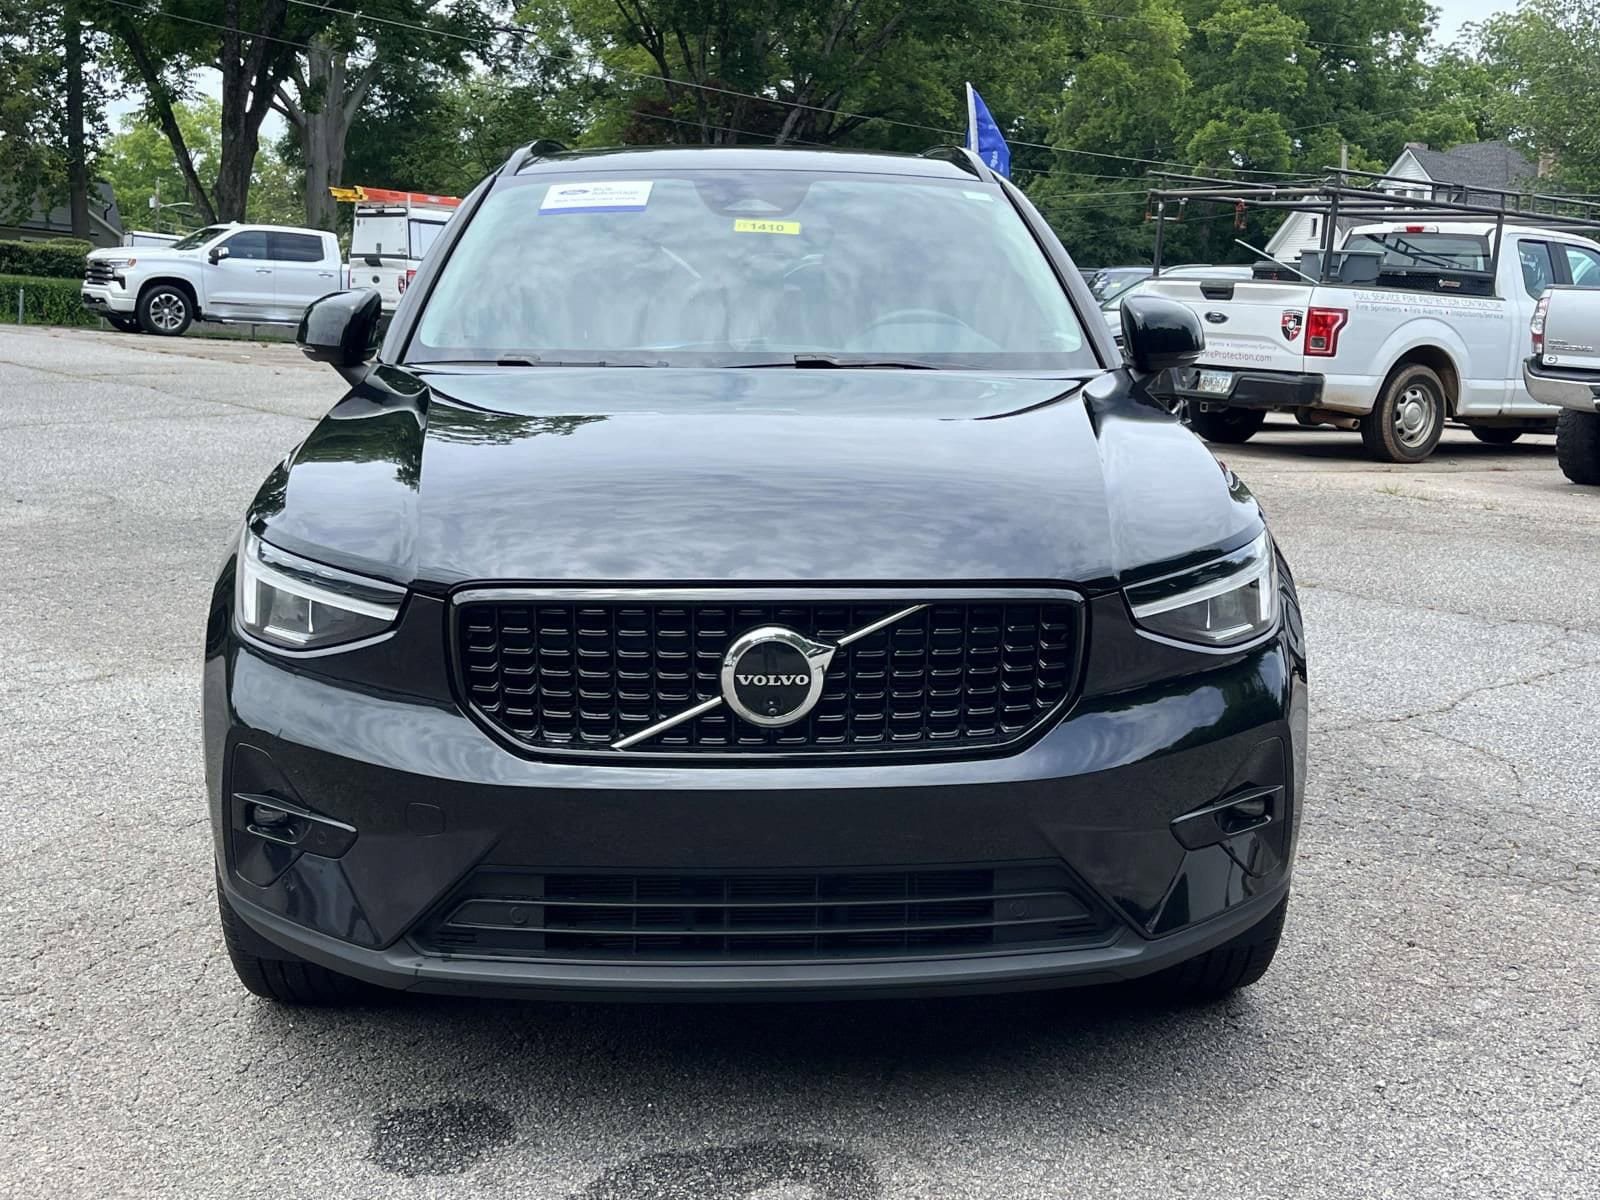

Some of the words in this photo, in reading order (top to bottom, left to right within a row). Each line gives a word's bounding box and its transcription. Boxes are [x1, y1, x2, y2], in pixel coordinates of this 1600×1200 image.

[1353, 292, 1371, 300] FULL
[1372, 293, 1401, 302] SERVICE
[1402, 295, 1417, 303] FIRE
[1419, 296, 1459, 306] PROTECTION
[1461, 299, 1503, 310] CONTRACTOR
[736, 674, 809, 686] VOLVO
